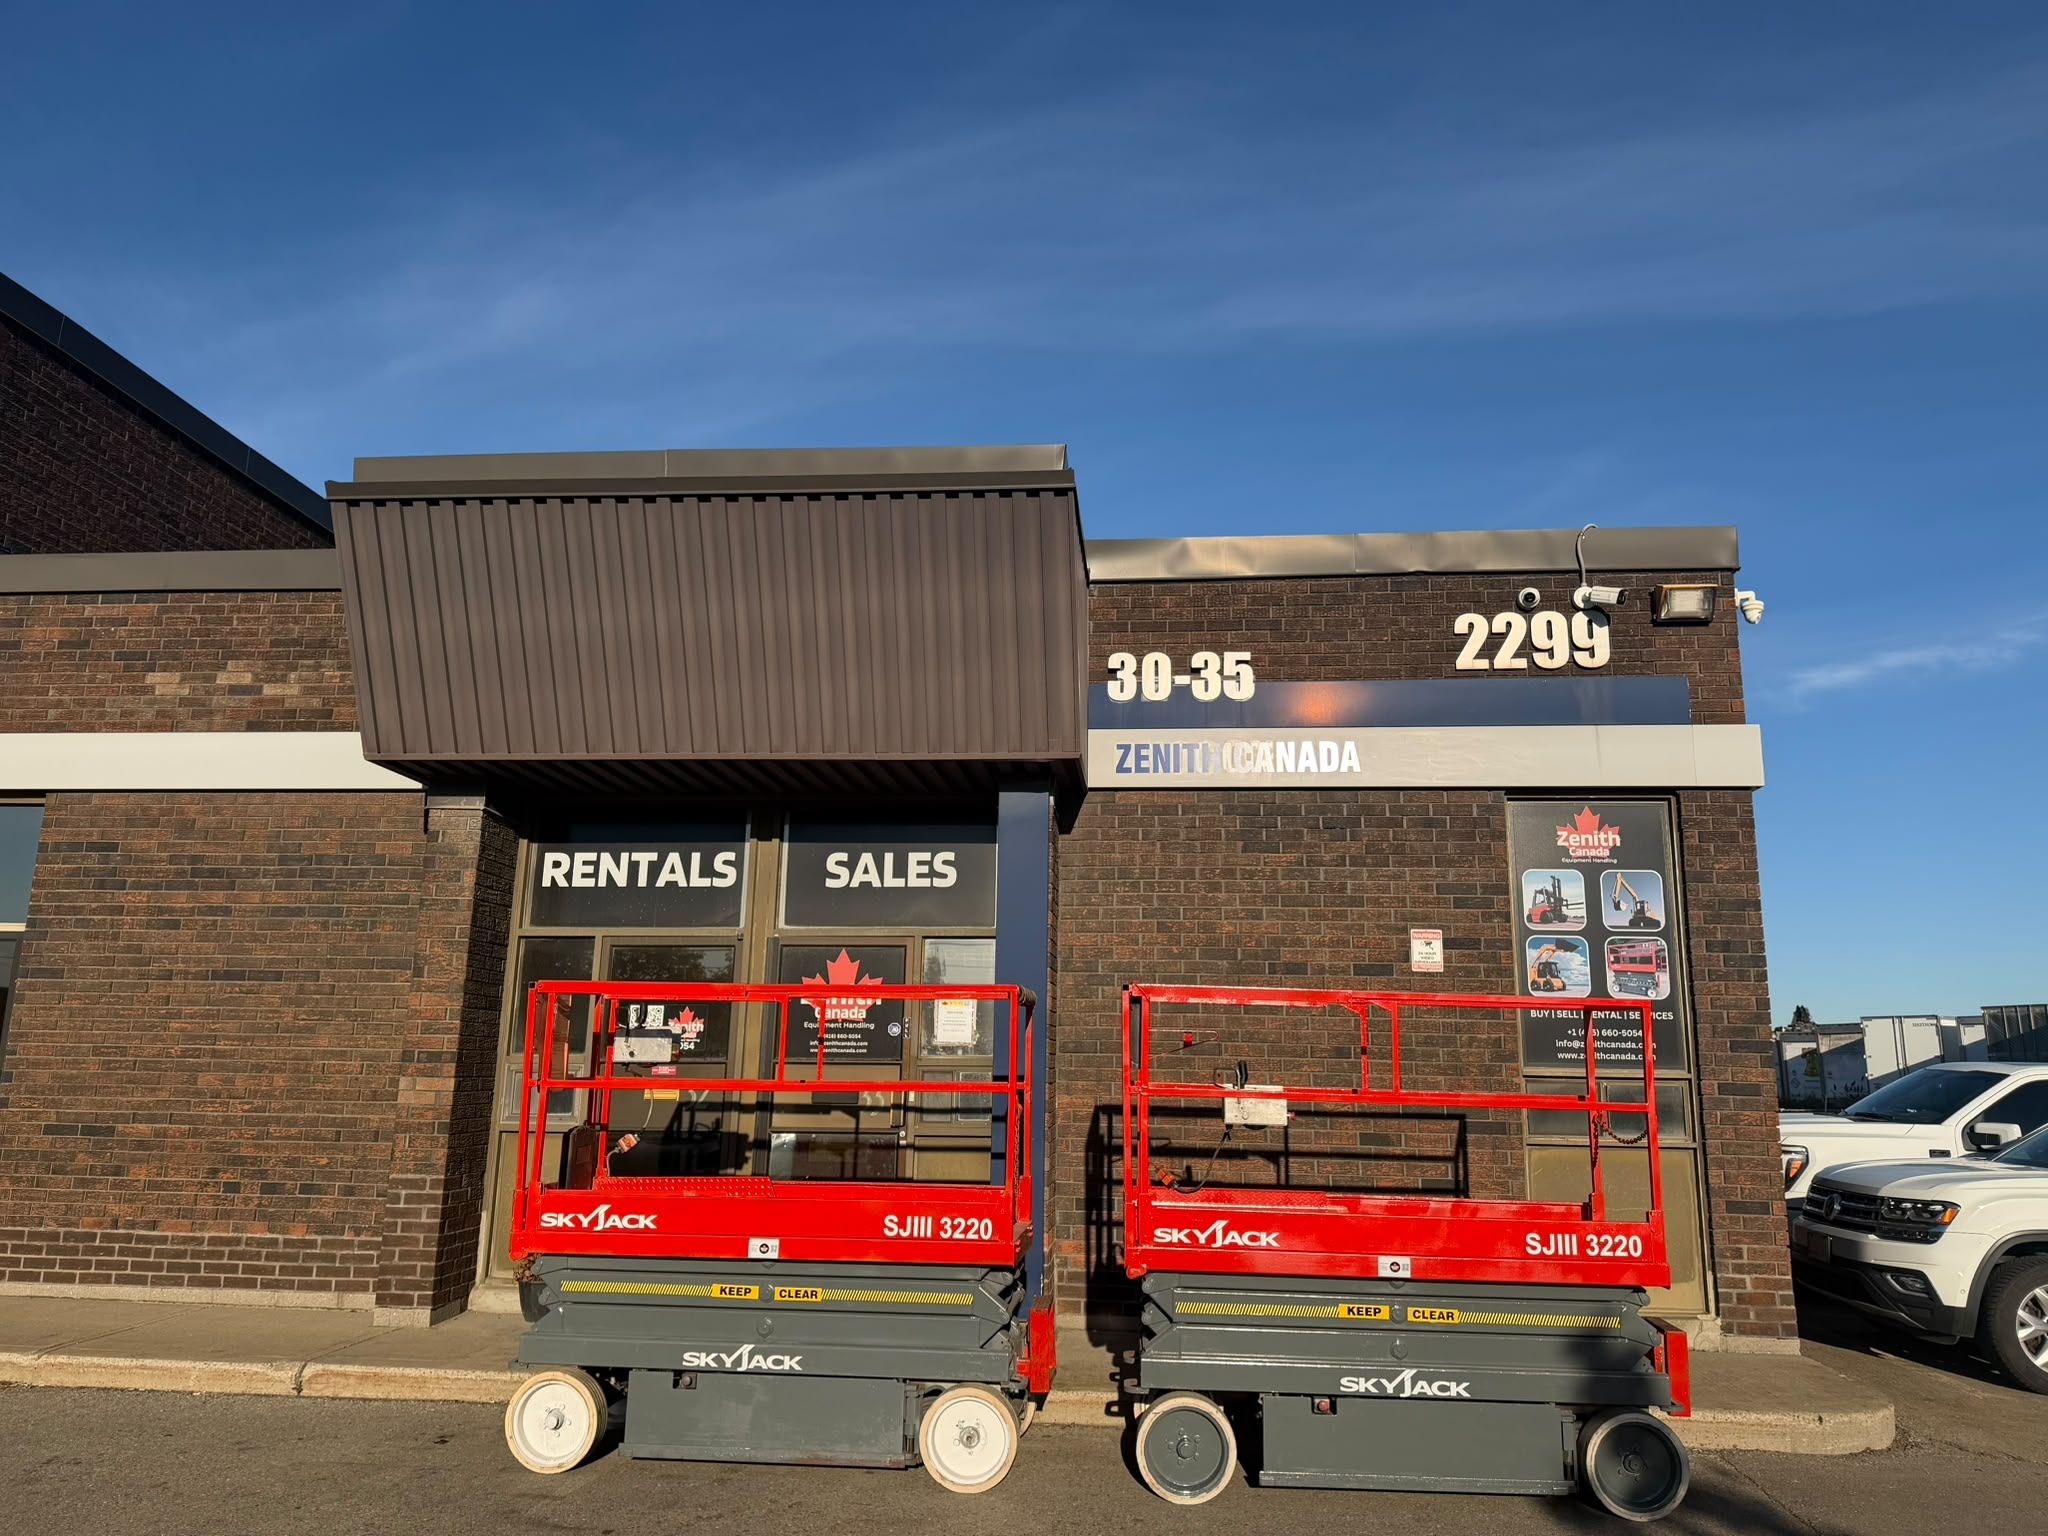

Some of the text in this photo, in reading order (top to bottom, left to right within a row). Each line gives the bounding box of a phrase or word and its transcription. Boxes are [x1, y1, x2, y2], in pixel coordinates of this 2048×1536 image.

[1454, 611, 1611, 670] 2299
[1107, 652, 1256, 702] 30-35
[1115, 741, 1361, 774] ZENITH CANADA
[1556, 830, 1621, 847] Zenith
[1568, 846, 1610, 857] Canada
[541, 851, 738, 888] RENTALS
[824, 851, 958, 888] SALES
[843, 1021, 875, 1030] Handling
[1530, 1010, 1549, 1018] BUY
[1556, 1010, 1579, 1018] SELL
[1591, 1011, 1624, 1019] ENTAL
[1629, 1011, 1674, 1020] SEICES
[1601, 1029, 1643, 1037] 660-5054
[540, 1204, 657, 1231] SKYJACK
[883, 1214, 993, 1240] SJIII 3220
[1153, 1219, 1280, 1248] SKYJACK
[1525, 1233, 1643, 1258] SJIII 3220
[719, 1286, 819, 1300] KEEP CLEAR
[1347, 1306, 1455, 1322] KEEP CLEAR
[682, 1344, 803, 1371] SKYJACK
[1339, 1368, 1471, 1398] SKYJACK
